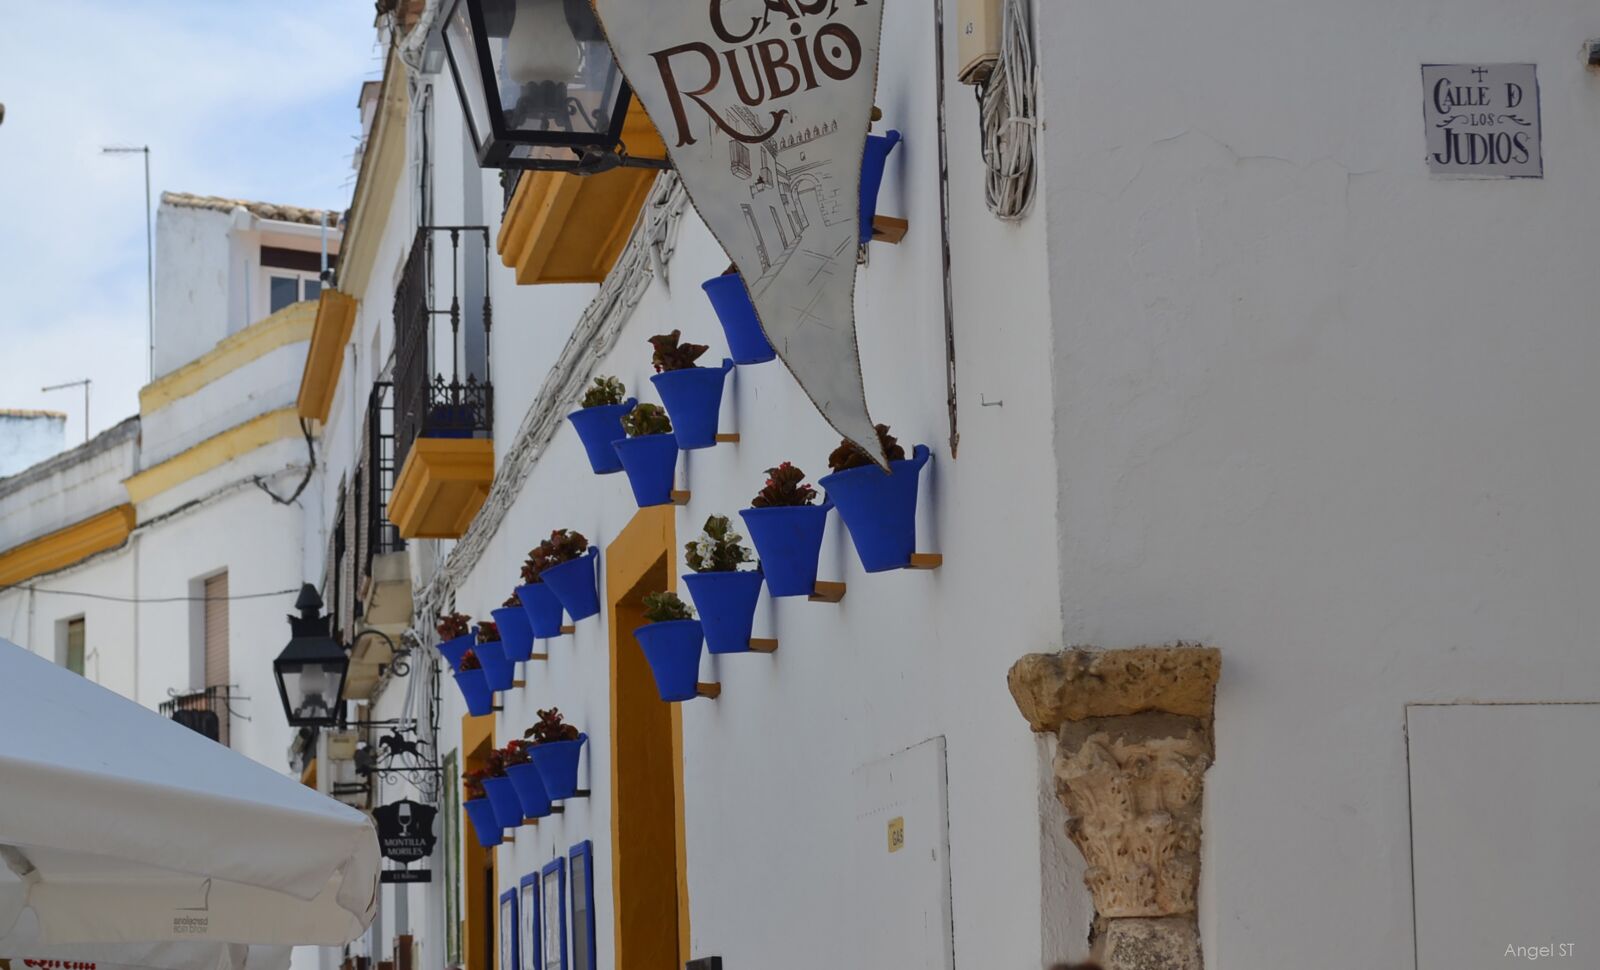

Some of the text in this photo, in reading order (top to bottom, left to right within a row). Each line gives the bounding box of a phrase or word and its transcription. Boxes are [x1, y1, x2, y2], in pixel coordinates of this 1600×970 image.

[1433, 77, 1491, 114] CALLE
[1470, 113, 1495, 126] LOS
[1432, 128, 1531, 165] JUDIOS
[384, 838, 426, 846] MONTILLA
[387, 847, 424, 855] MORILES
